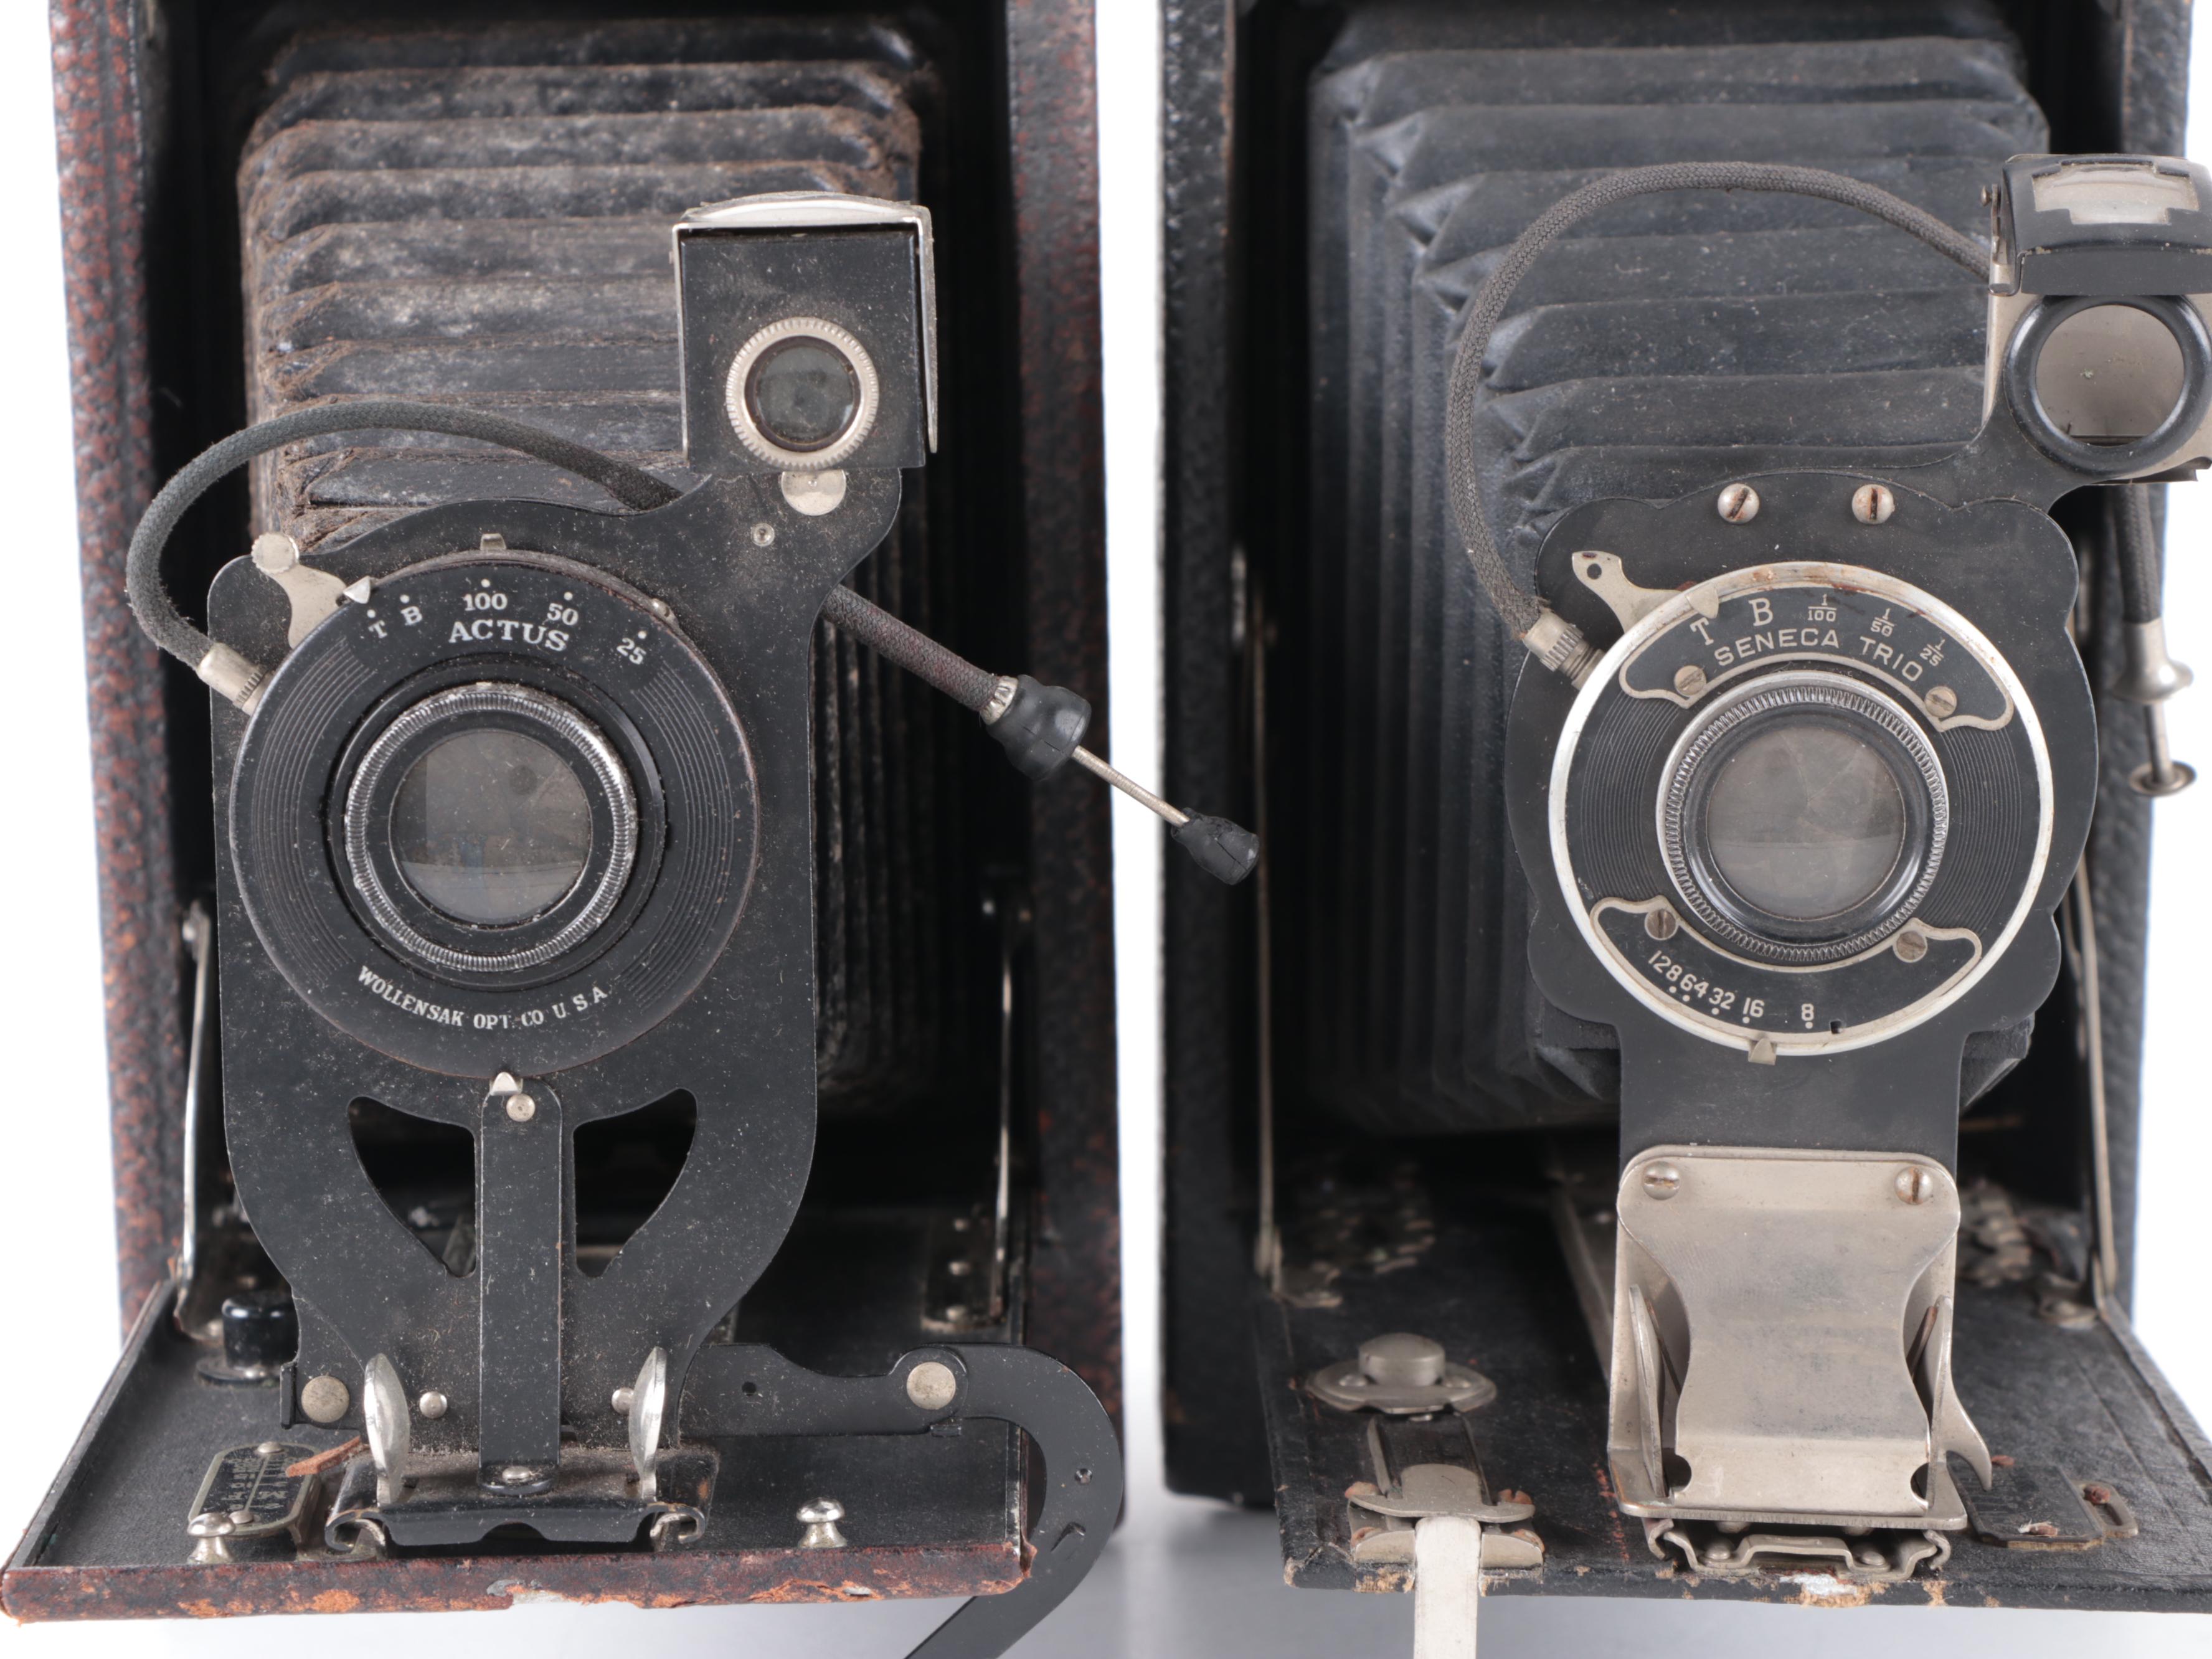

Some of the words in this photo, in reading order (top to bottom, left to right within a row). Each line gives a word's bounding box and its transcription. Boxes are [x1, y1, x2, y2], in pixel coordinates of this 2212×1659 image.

[369, 620, 388, 639] T
[400, 605, 423, 626] B
[463, 592, 508, 612] 100
[546, 602, 579, 626] 50
[616, 637, 647, 665] 25
[448, 619, 570, 651] ACTUS
[1690, 617, 1714, 646] T
[1748, 597, 1774, 626] B
[1714, 628, 1840, 667] SENECA
[1860, 636, 1923, 682] TRIO
[358, 965, 465, 1027] WOLLENSAK
[1648, 950, 1683, 981] 128
[1680, 973, 1709, 998] 64
[1708, 987, 1736, 1009] 32
[1742, 997, 1765, 1018] 16
[1801, 1003, 1815, 1021] 8
